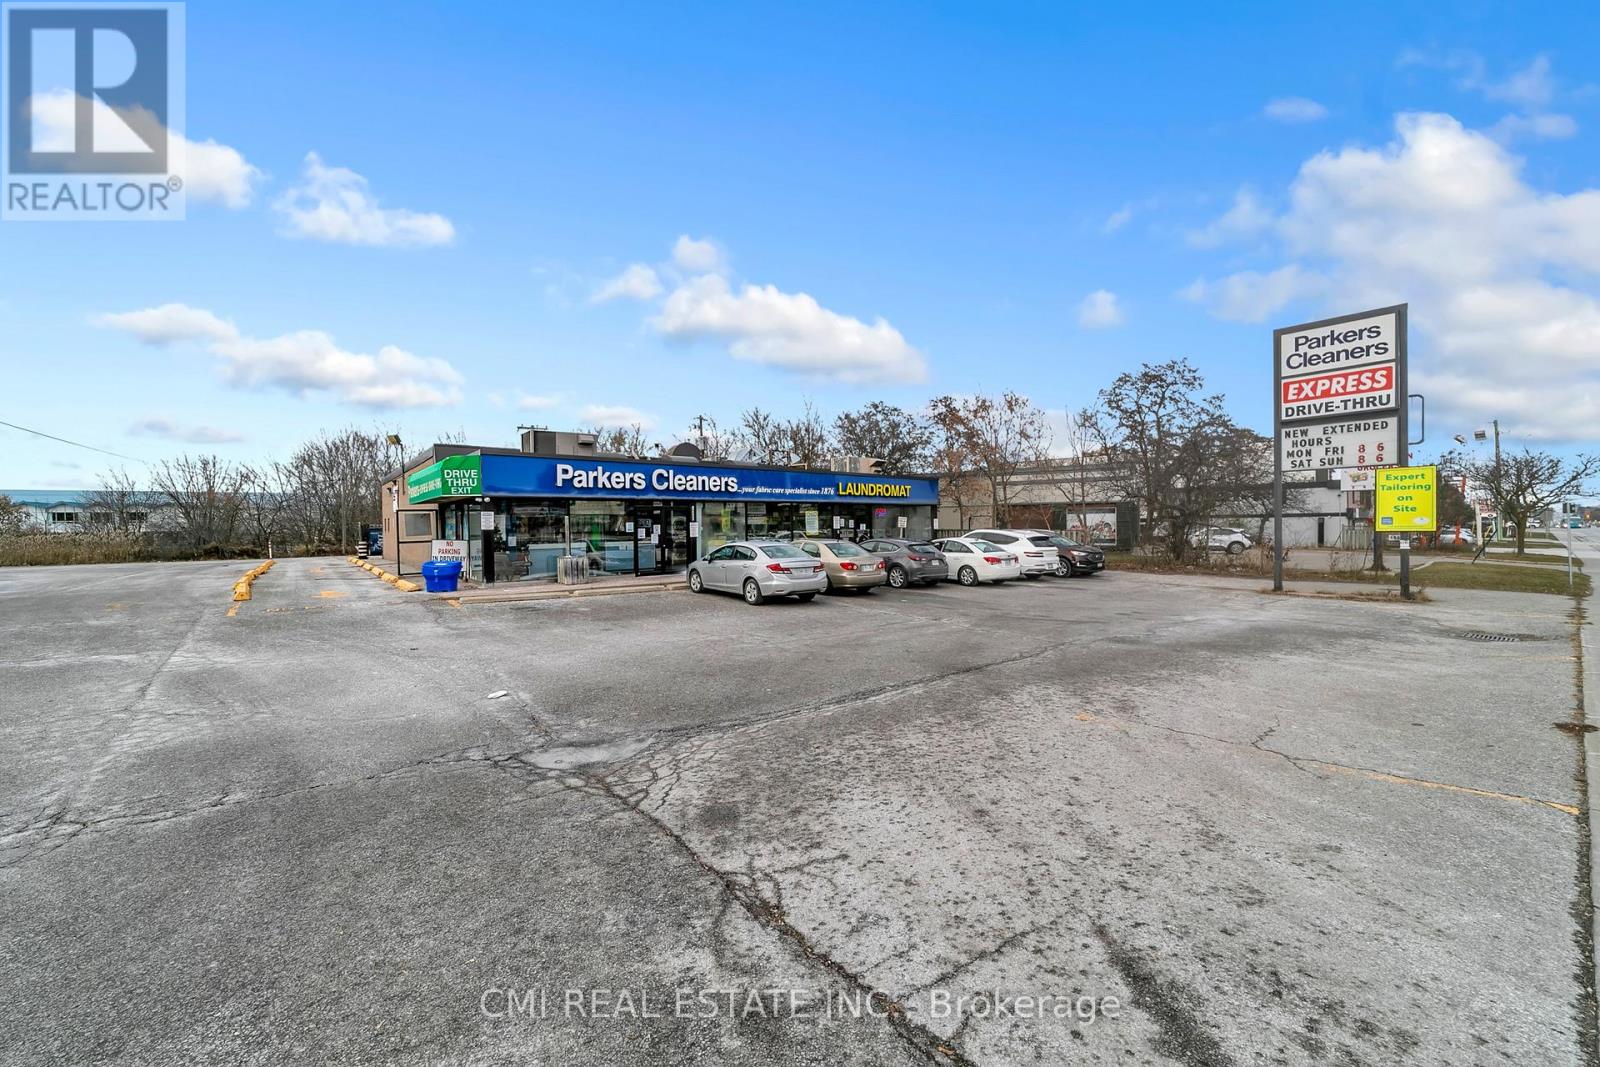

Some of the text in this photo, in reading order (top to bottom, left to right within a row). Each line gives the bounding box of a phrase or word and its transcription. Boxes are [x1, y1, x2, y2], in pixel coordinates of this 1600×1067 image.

[1294, 325, 1381, 353] Parkers
[1286, 341, 1389, 369] Cleaners
[1287, 369, 1388, 401] EXPRESS
[1285, 394, 1391, 418] DRIVE-THRU
[1284, 420, 1389, 439] NEW EXTENDED
[1292, 437, 1332, 448] HOURS
[1286, 442, 1385, 459] MON FRI 8 6
[1290, 459, 1313, 469] SAT
[1358, 455, 1366, 464] 8
[1376, 453, 1384, 463] 6
[444, 469, 478, 478] DRIVE
[556, 464, 646, 490] Parkers
[652, 468, 738, 493] Cleaners
[756, 485, 772, 496] fabric
[785, 487, 807, 496] specialist
[807, 487, 821, 495] since
[1385, 473, 1426, 482] Expert
[447, 478, 477, 487] THRU
[838, 482, 911, 497] LAUNDROMAT
[1380, 483, 1432, 492] Tailoring
[451, 487, 472, 495] EXIT
[1393, 505, 1417, 513] Site
